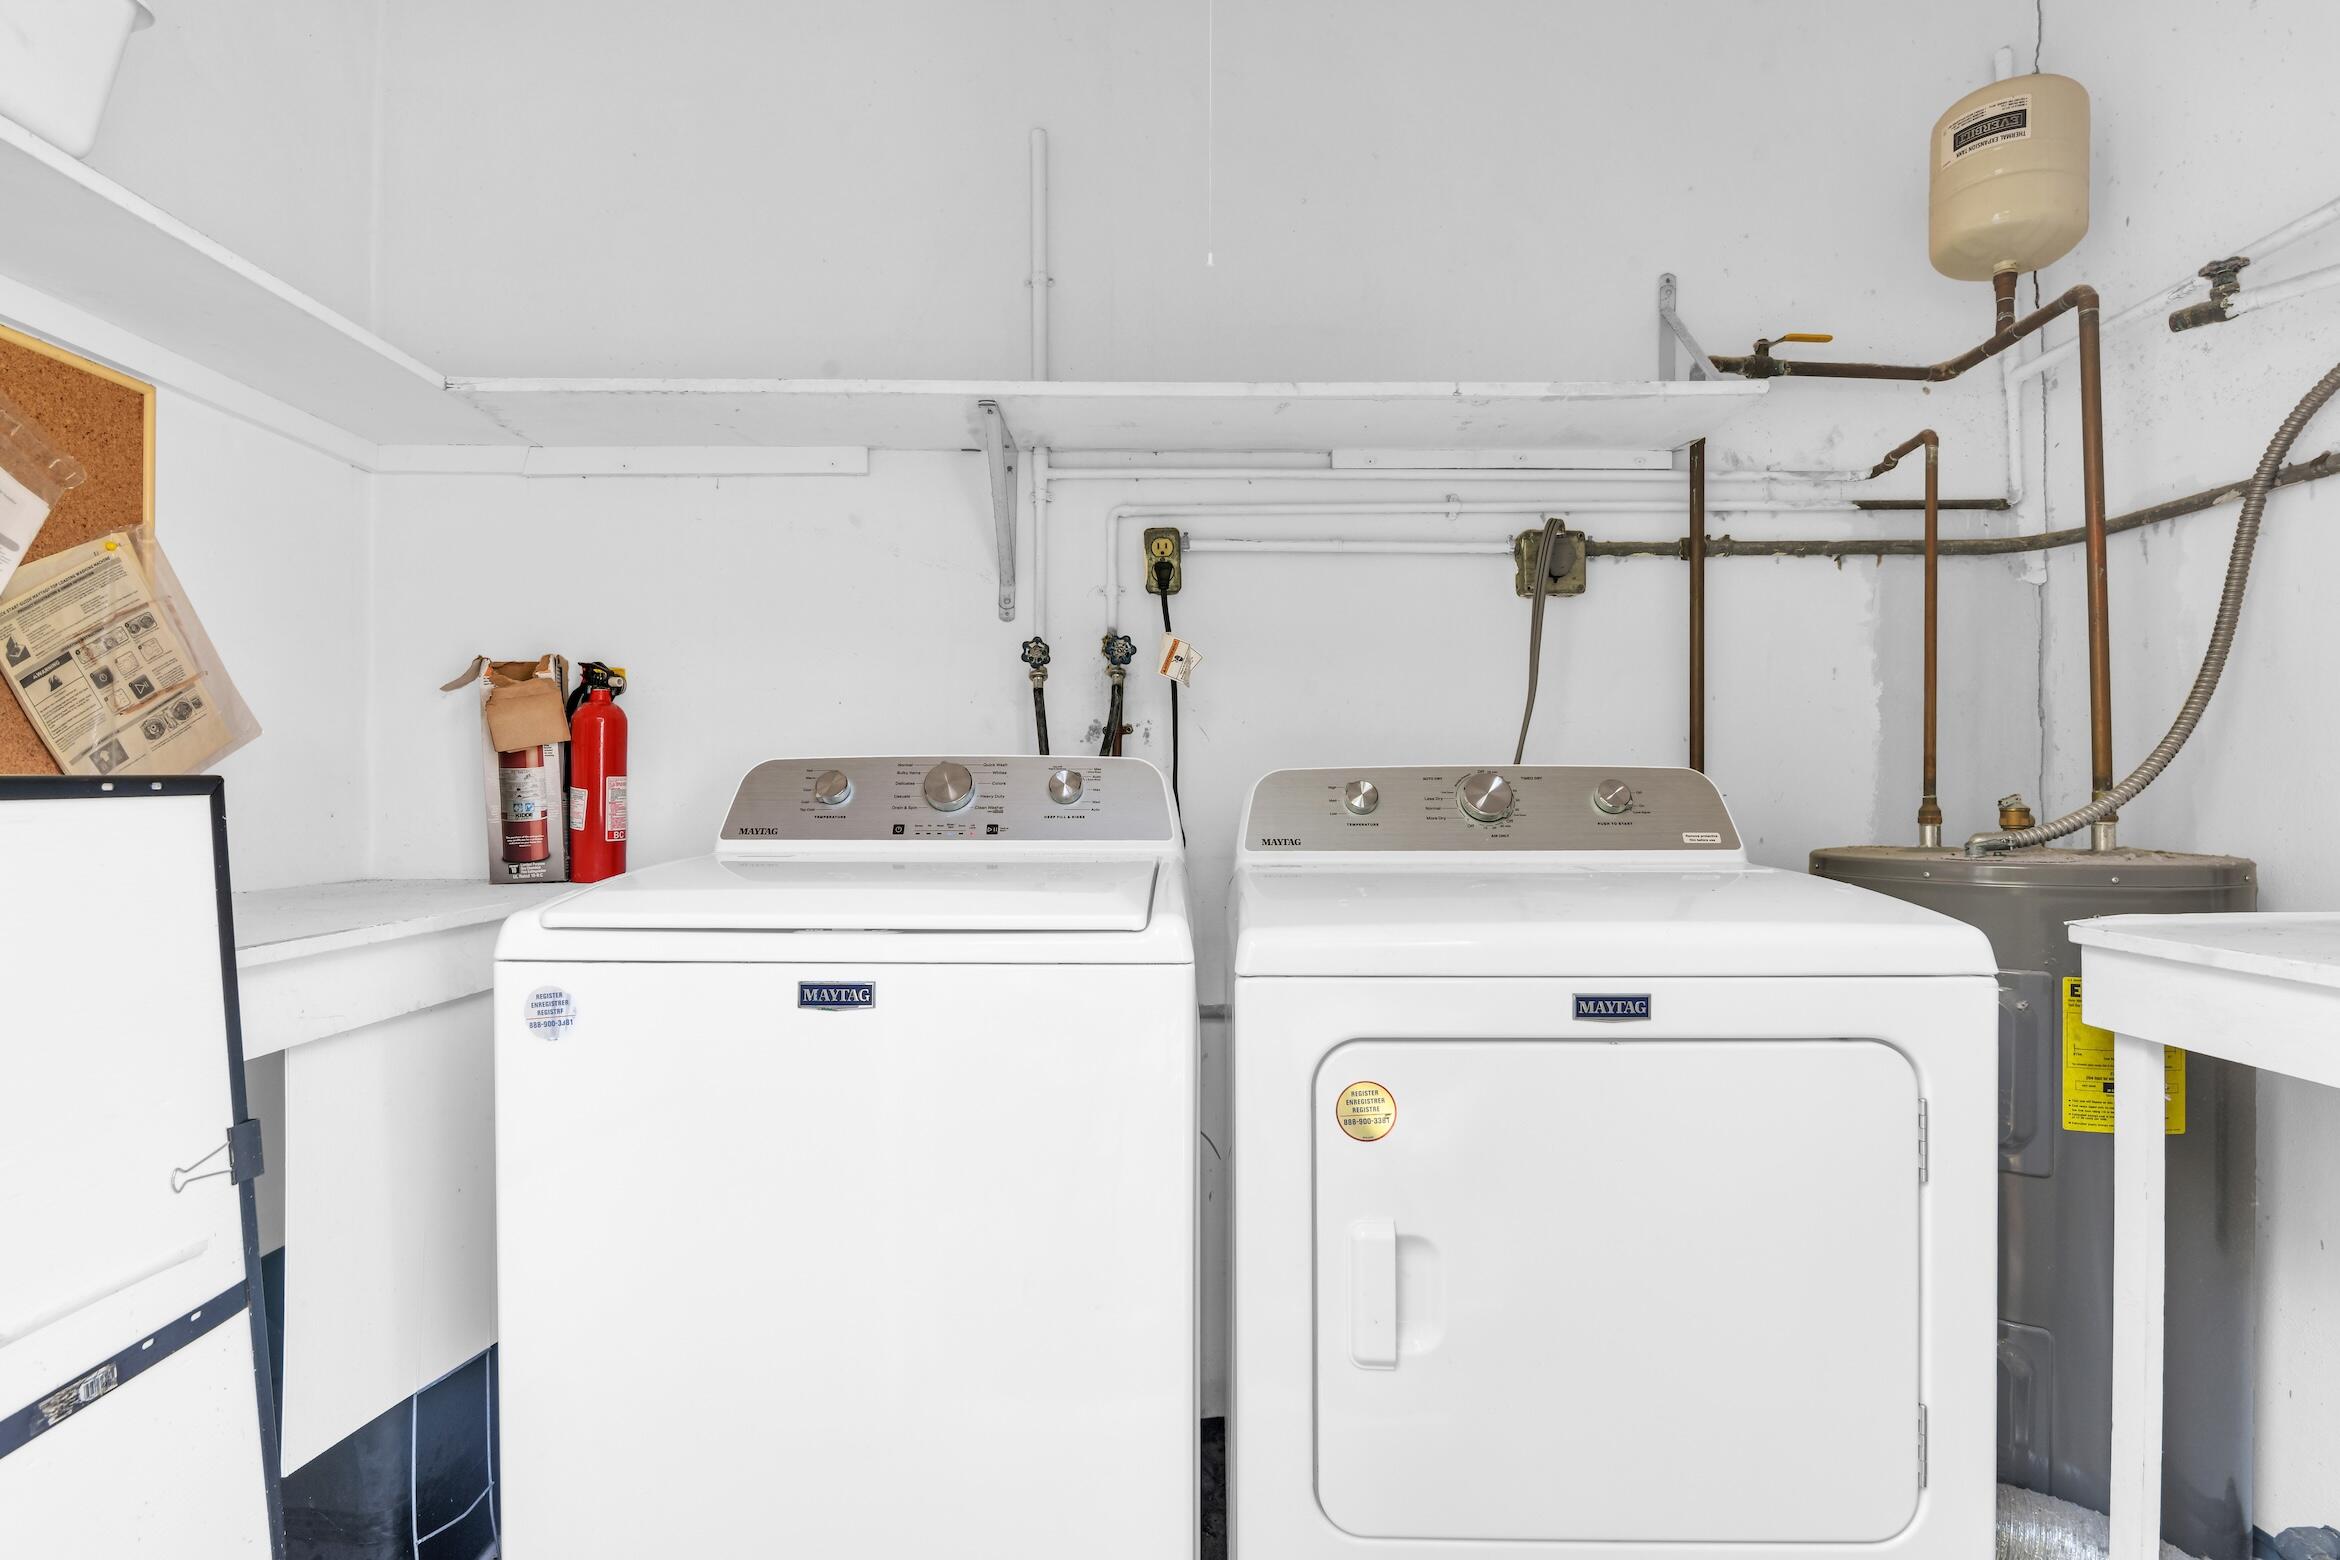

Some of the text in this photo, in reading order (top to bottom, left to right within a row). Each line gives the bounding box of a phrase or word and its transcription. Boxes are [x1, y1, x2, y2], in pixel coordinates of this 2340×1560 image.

[2001, 130, 2026, 140] THERMAL
[1968, 137, 1999, 152] EXPANSION
[613, 831, 625, 839] BC
[738, 827, 779, 836] MAYTAG
[1260, 838, 1301, 846] MAYTAG
[536, 991, 563, 1000] REGISTER
[803, 988, 871, 1002] MAYTAG
[1578, 1000, 1647, 1014] MAYTAG
[1350, 1090, 1379, 1098] REGISTER
[1345, 1097, 1386, 1106] ENREGISTRER
